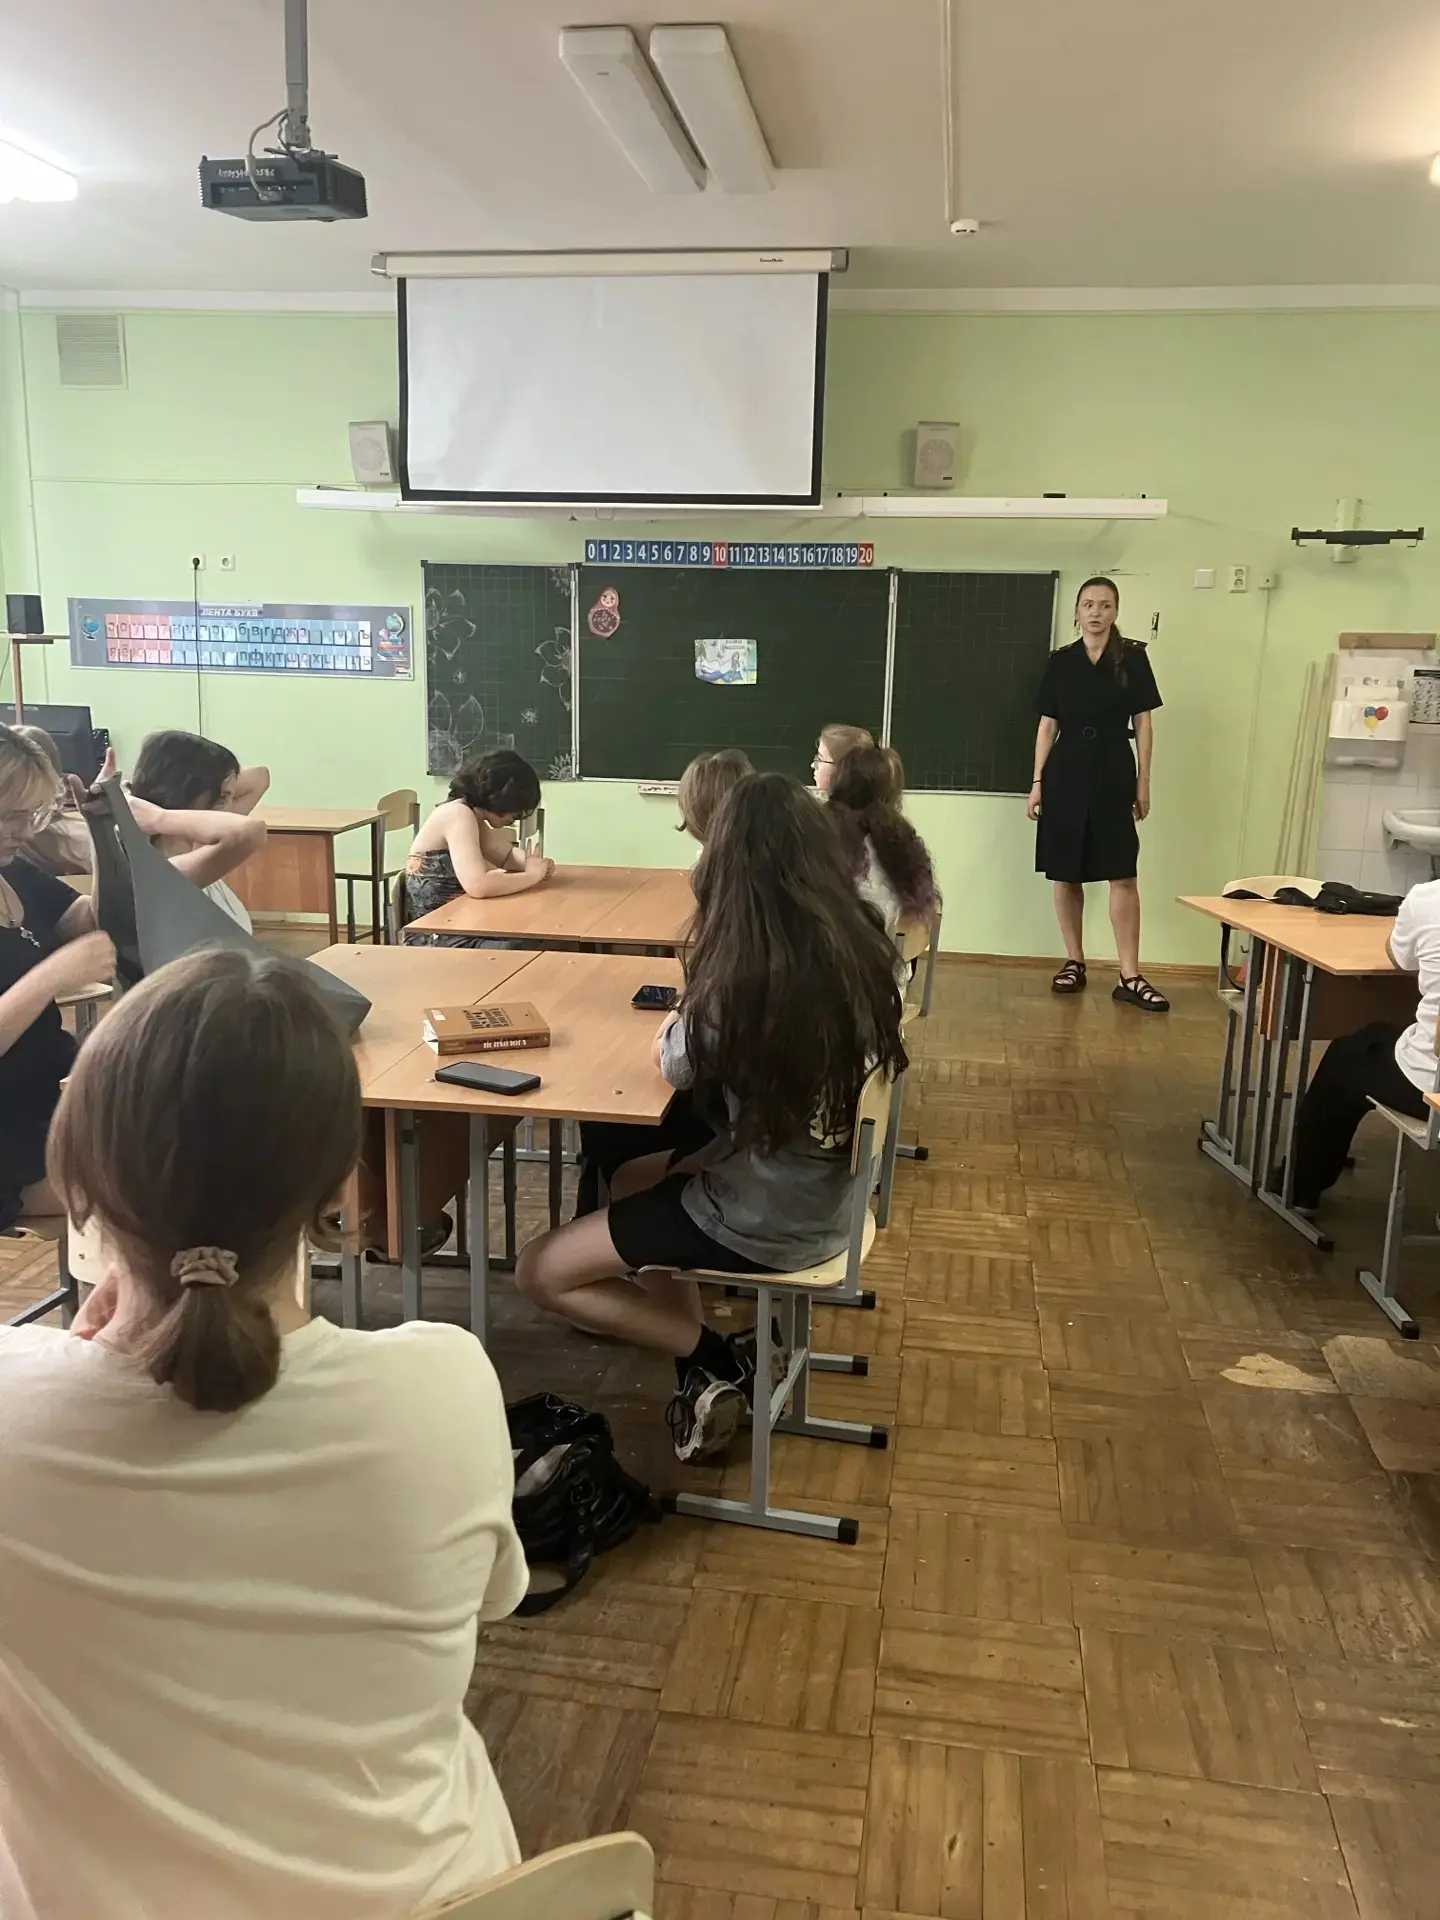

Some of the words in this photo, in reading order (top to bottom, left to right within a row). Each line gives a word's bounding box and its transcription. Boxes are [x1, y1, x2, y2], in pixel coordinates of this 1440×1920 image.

[588, 544, 595, 559] 0
[600, 544, 606, 559] 1
[613, 544, 620, 560] 2
[626, 544, 633, 560] 3
[638, 544, 646, 560] 4
[651, 545, 658, 560] 5
[664, 545, 672, 560] 6
[677, 546, 684, 561] 7
[690, 546, 698, 561] 8
[703, 546, 710, 561] 9
[714, 546, 726, 562] 10
[729, 547, 740, 562] 11
[743, 547, 755, 562] 12
[758, 547, 769, 563] 13
[772, 547, 785, 563] 14
[787, 547, 799, 563] 15
[802, 547, 814, 563] 16
[816, 547, 828, 563] 17
[831, 547, 843, 563] 18
[846, 547, 857, 563] 19
[860, 547, 872, 563] 20
[202, 608, 231, 616] ЛЕНТА
[236, 609, 258, 618] БУКВ
